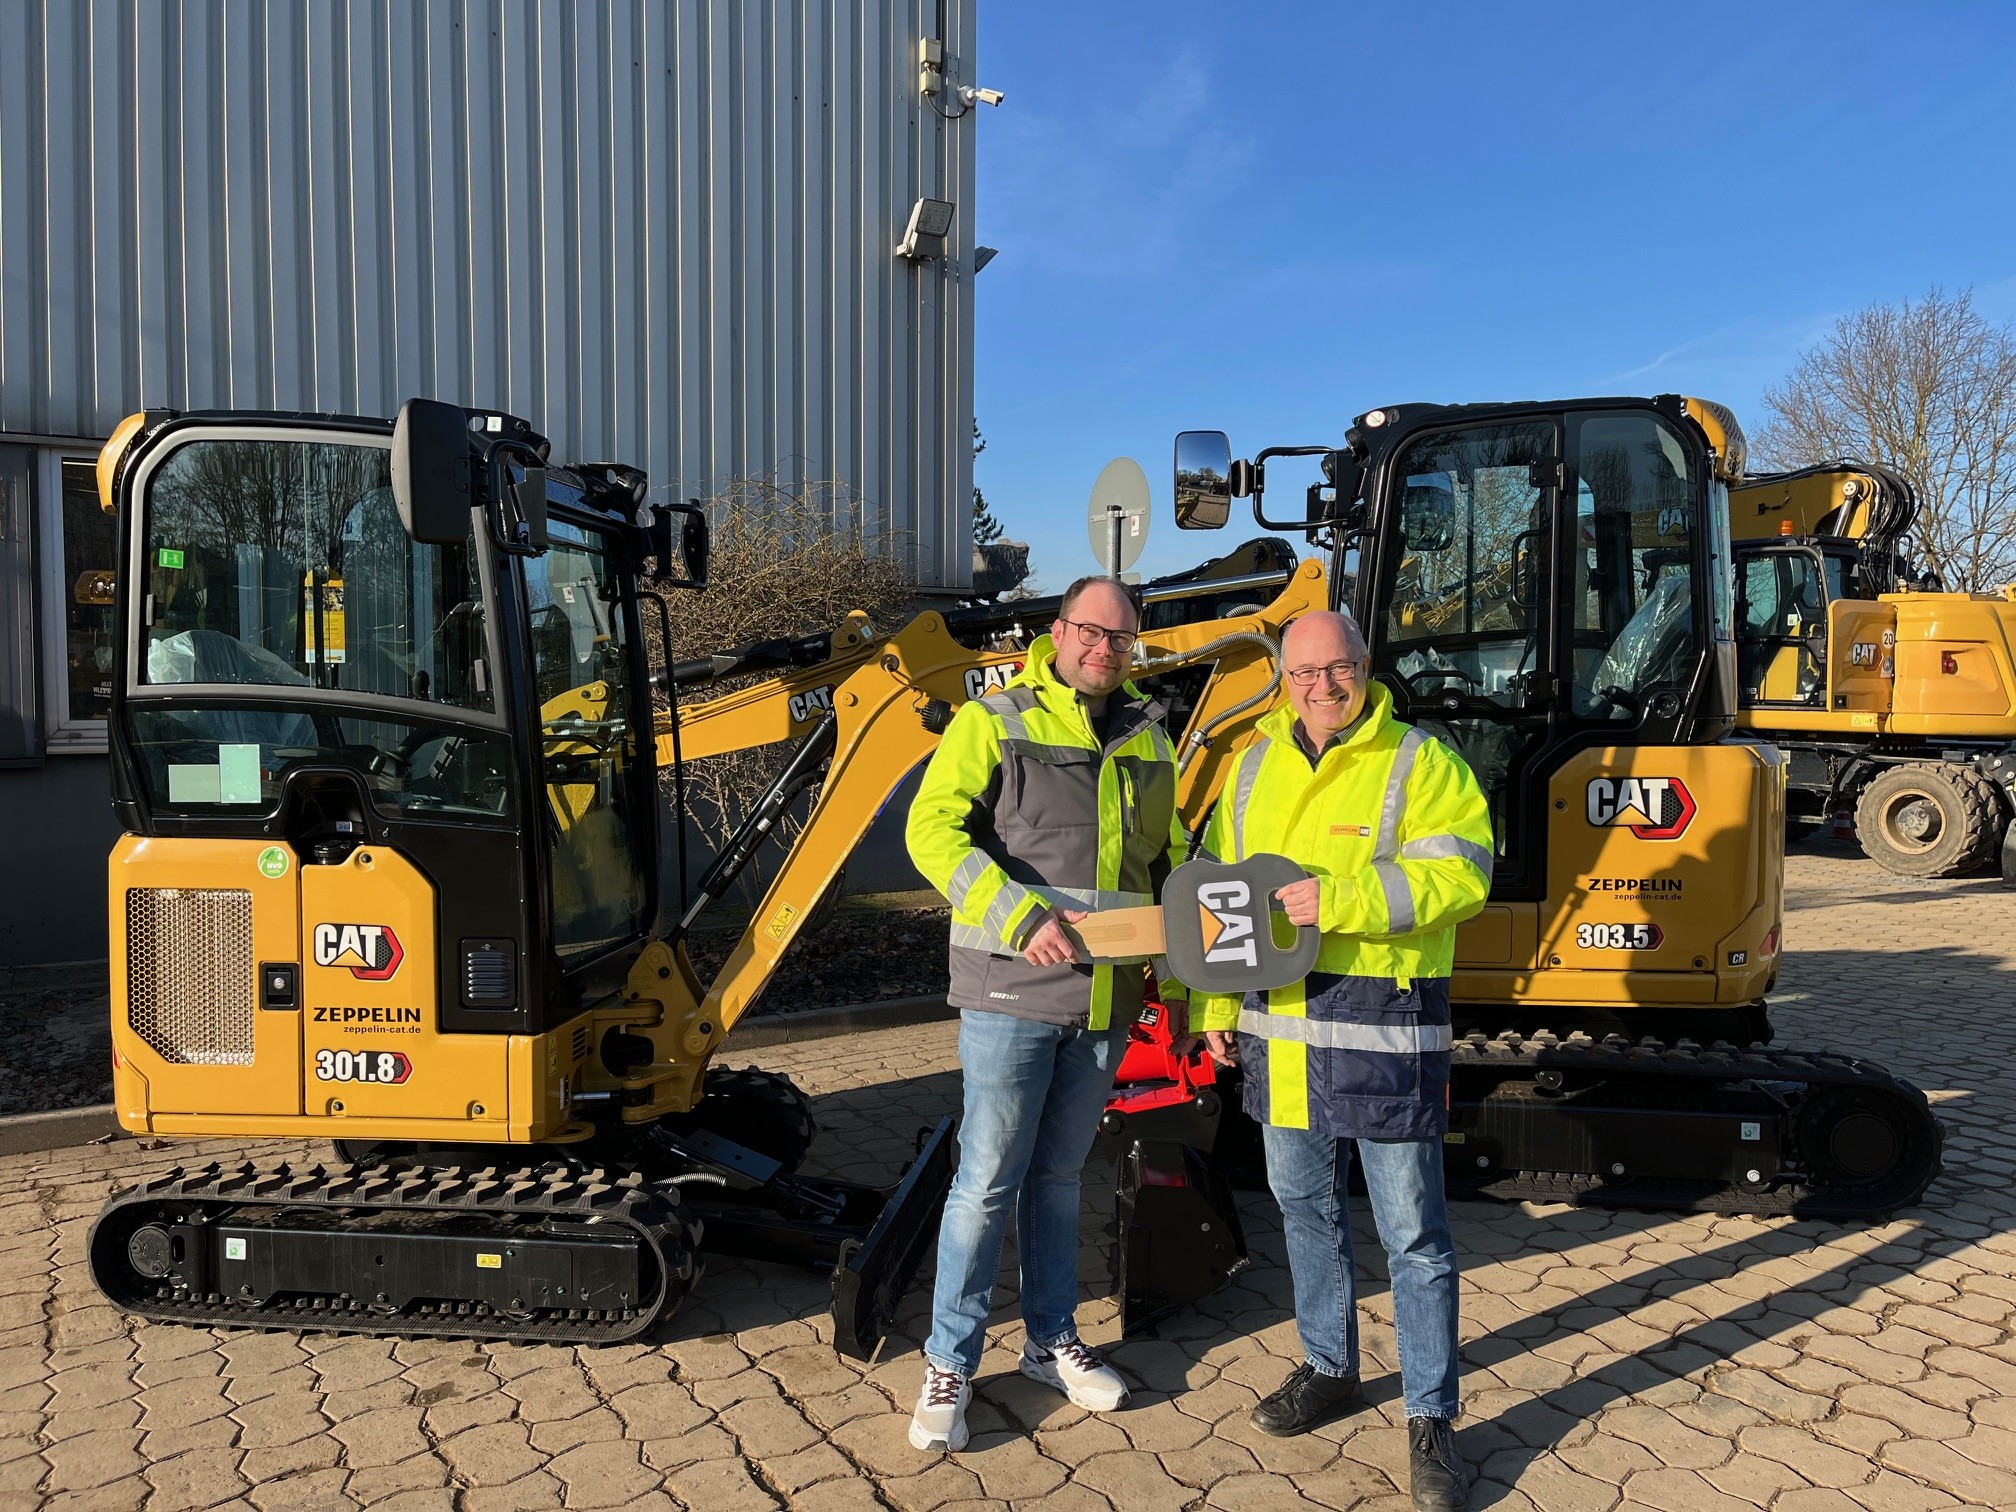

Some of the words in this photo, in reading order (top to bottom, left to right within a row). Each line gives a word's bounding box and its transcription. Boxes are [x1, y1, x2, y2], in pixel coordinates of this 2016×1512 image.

[1658, 509, 1688, 537] CA
[1884, 633, 1894, 645] 20
[1853, 643, 1877, 666] CAT
[789, 685, 831, 722] CAT
[1588, 778, 1669, 826] CAT
[1588, 879, 1682, 892] ZEPPELIN
[1614, 893, 1682, 901] zeppelin-cat.de
[1197, 880, 1258, 967] CAT
[315, 924, 382, 968] CAT
[1577, 924, 1649, 949] 303.5
[1732, 953, 1744, 964] CR
[313, 1007, 421, 1023] ZEPPELIN
[343, 1025, 421, 1035] zeppelin-cat.de
[316, 1050, 395, 1082] 301.8
